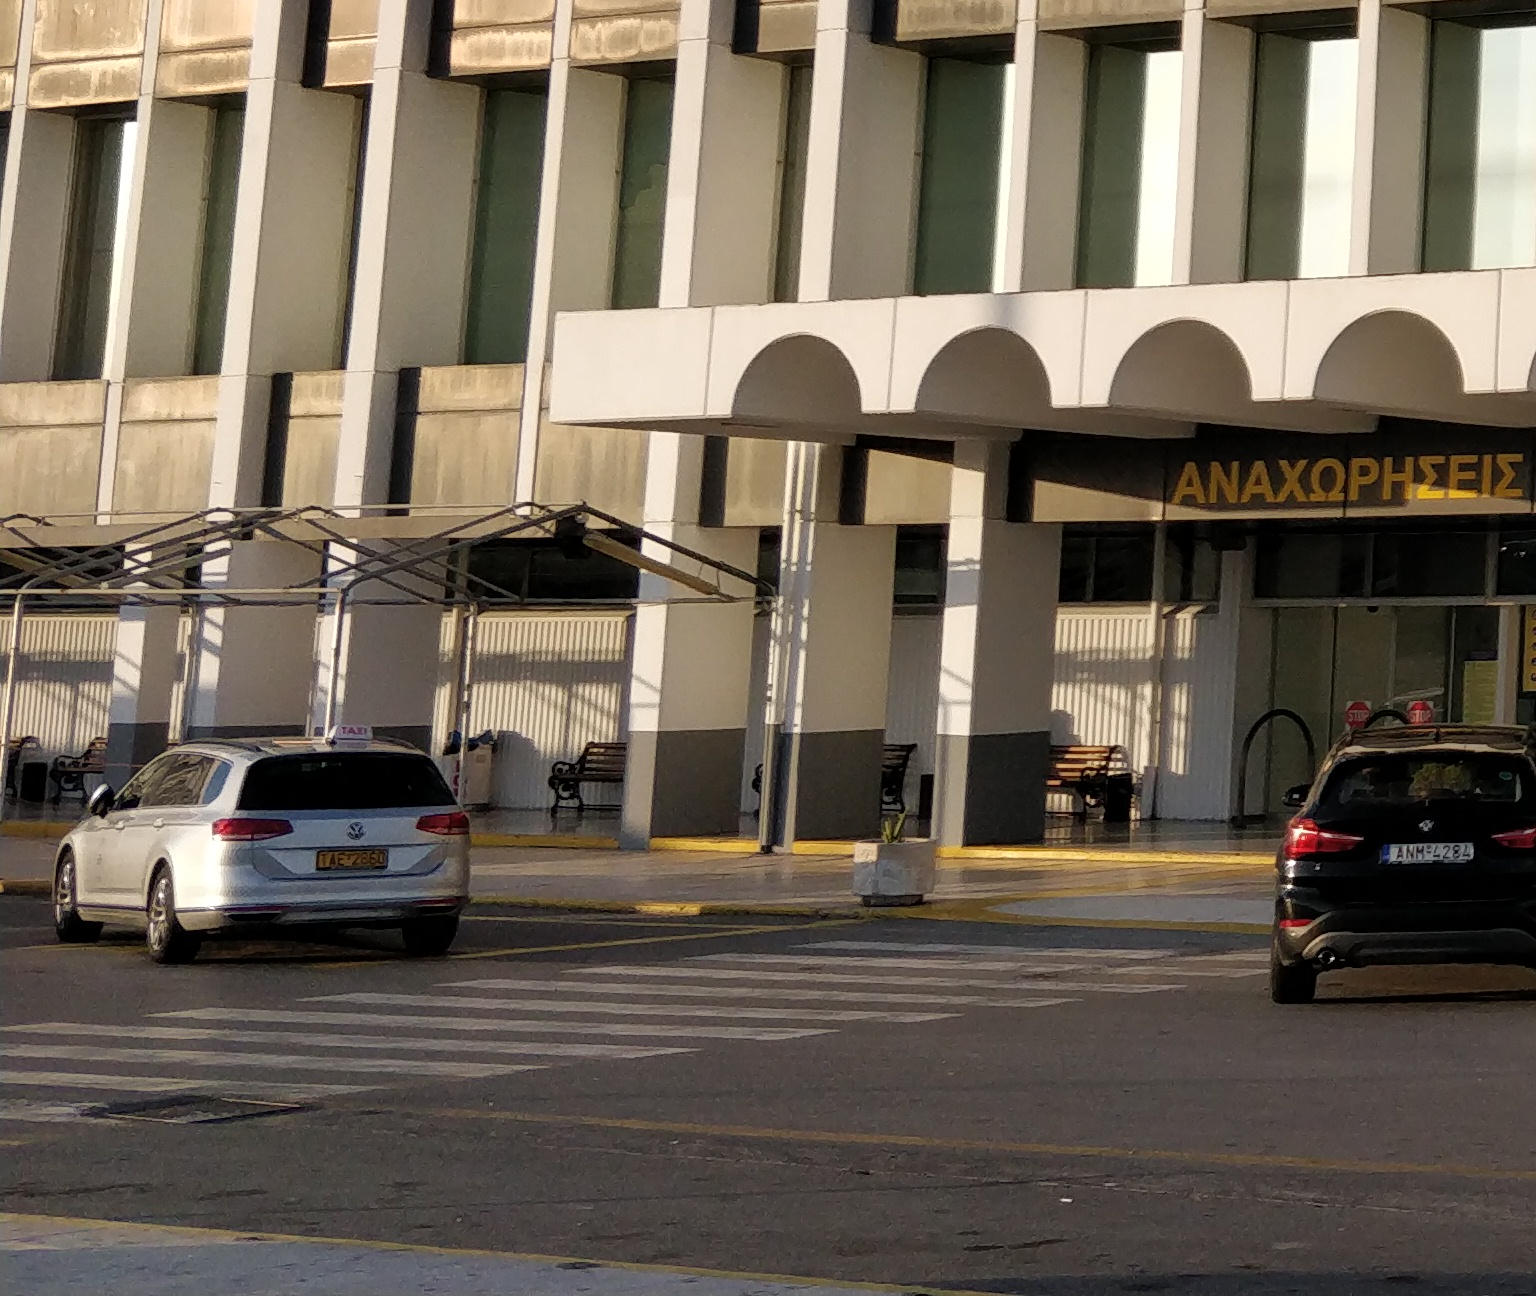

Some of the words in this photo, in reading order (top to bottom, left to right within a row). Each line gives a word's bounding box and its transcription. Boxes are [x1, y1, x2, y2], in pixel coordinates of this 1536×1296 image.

[1171, 454, 1526, 505] ΑΝΑΧΩΡΗΣΕΙΣ
[1348, 710, 1370, 722] STOP
[1410, 710, 1432, 723] STOP
